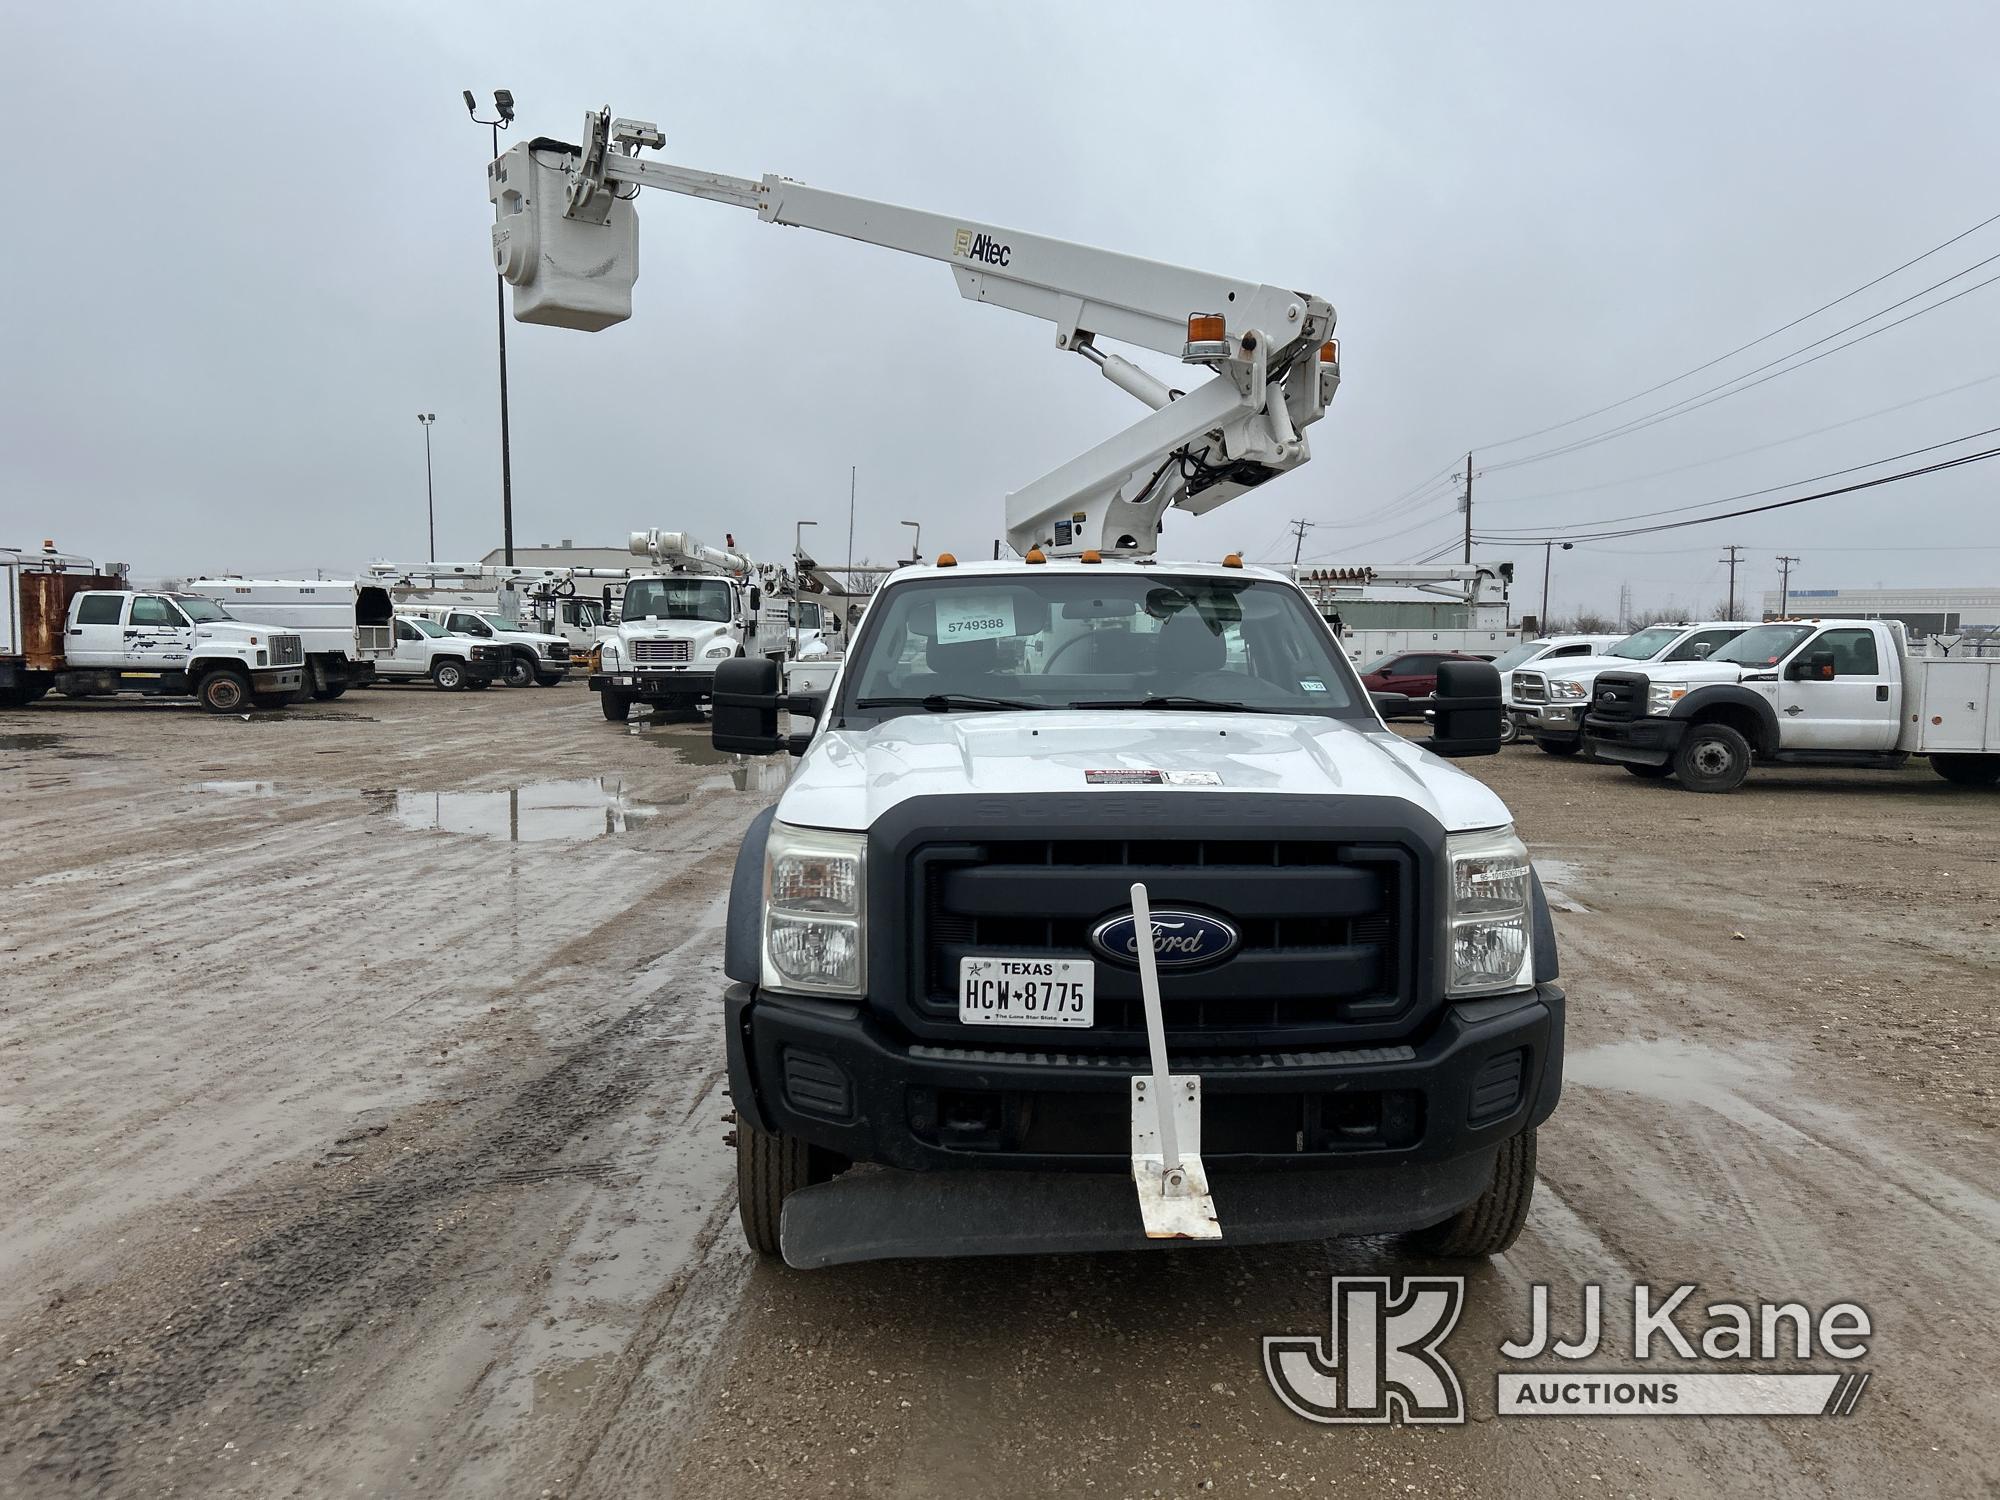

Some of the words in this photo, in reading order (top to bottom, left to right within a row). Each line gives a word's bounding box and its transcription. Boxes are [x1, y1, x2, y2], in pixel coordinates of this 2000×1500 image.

[969, 233, 1011, 267] Altec
[948, 618, 1004, 633] 5749388
[1001, 962, 1053, 976] TEXAS
